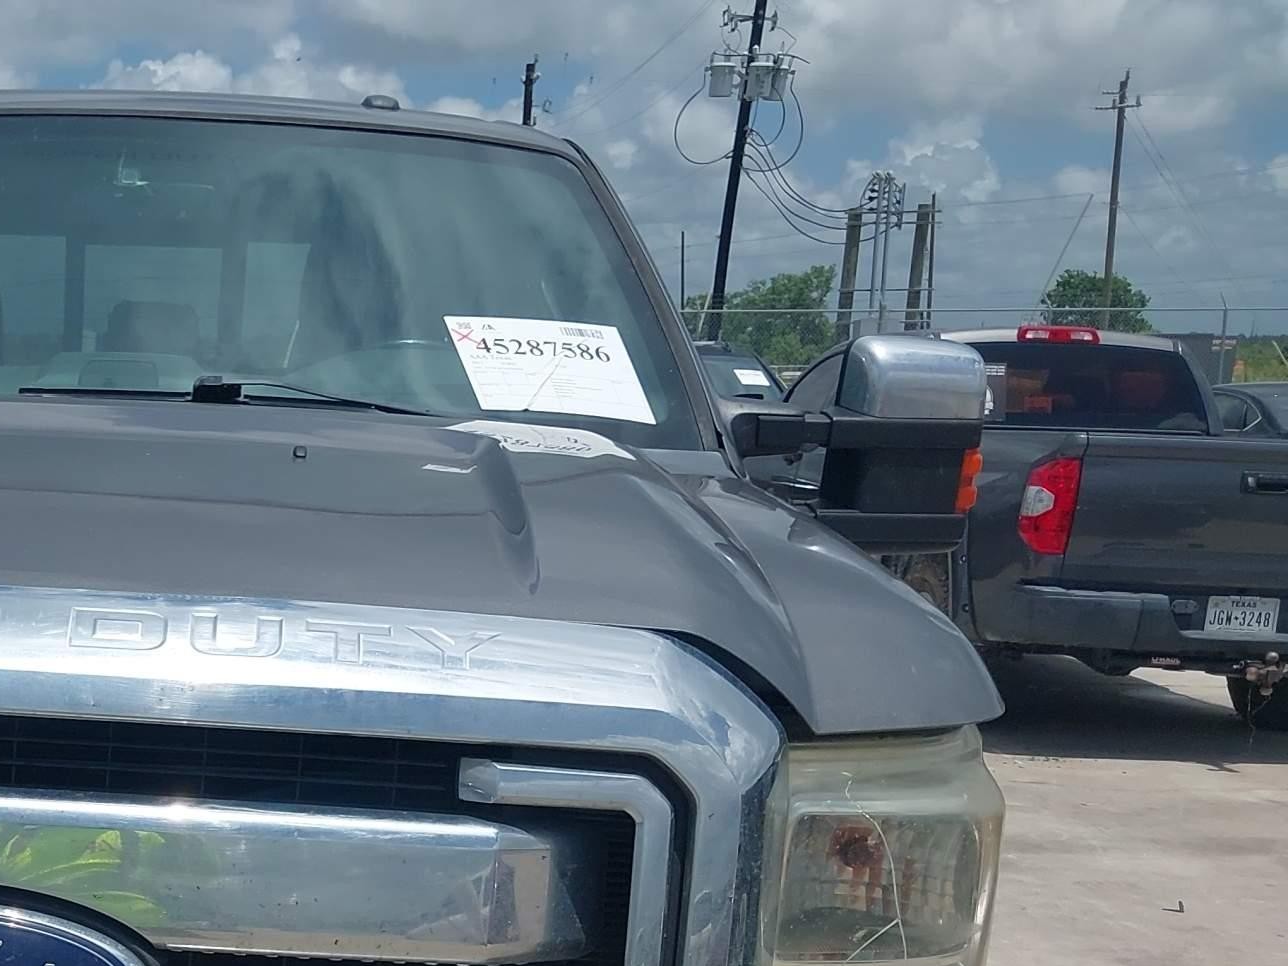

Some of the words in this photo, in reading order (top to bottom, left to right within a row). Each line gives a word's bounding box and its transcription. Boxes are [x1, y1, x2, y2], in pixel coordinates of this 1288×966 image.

[475, 337, 612, 363] 45287586
[1231, 600, 1257, 608] TEXAS
[68, 606, 502, 670] DUTY
